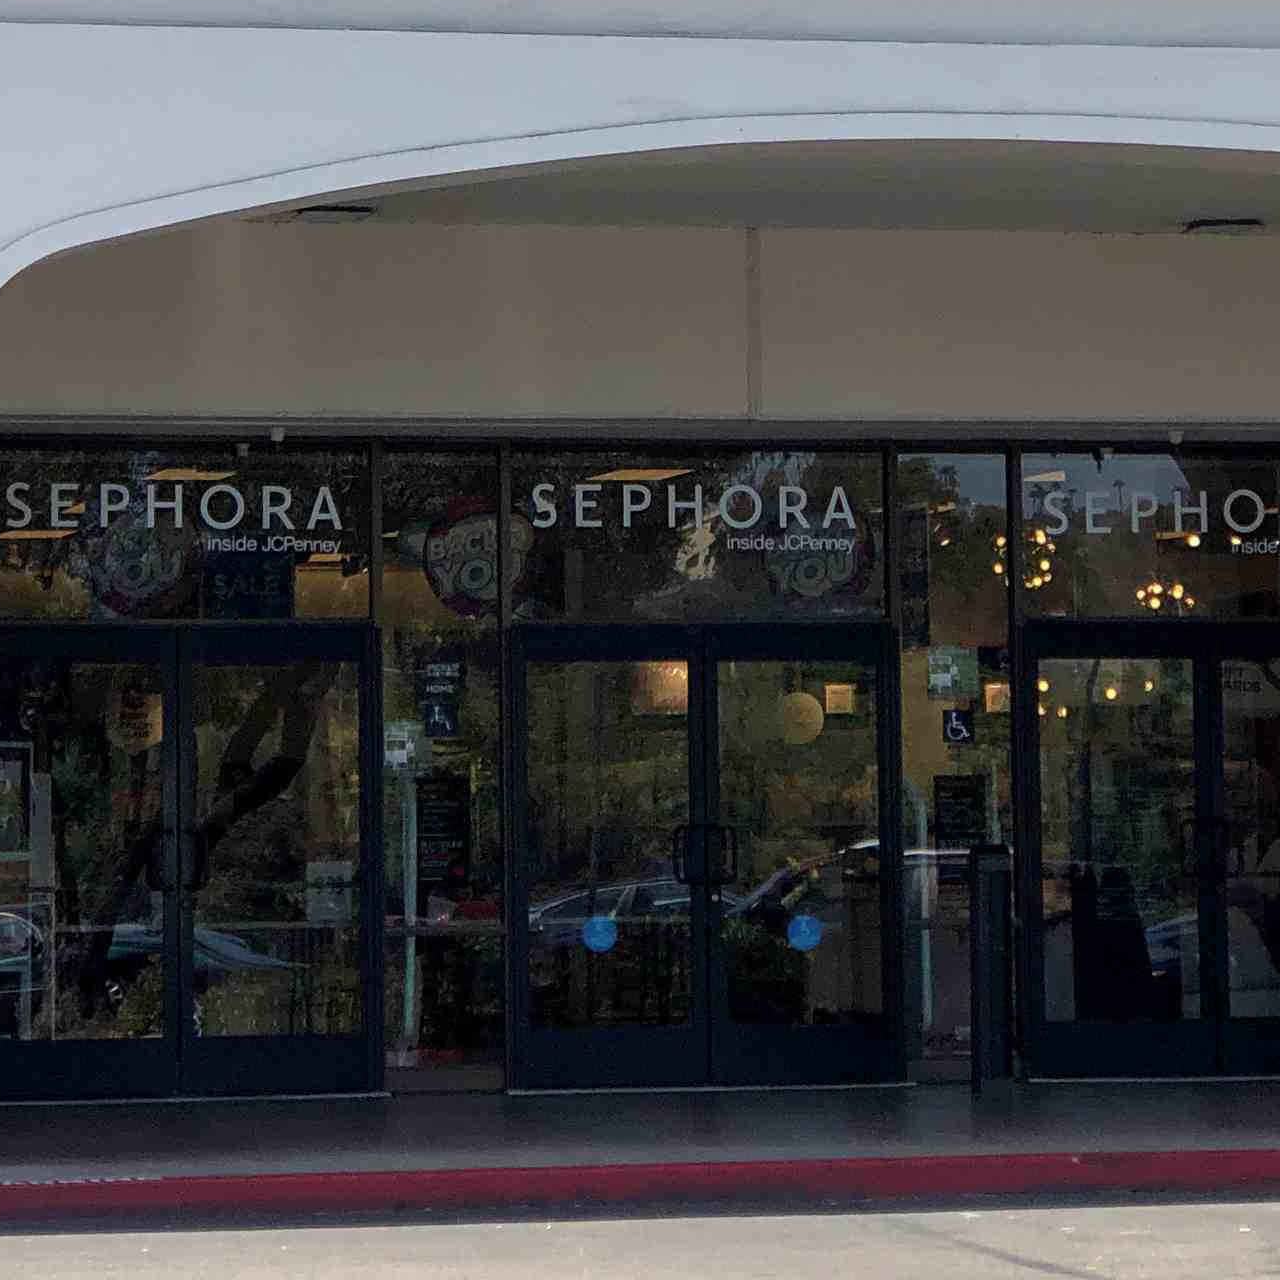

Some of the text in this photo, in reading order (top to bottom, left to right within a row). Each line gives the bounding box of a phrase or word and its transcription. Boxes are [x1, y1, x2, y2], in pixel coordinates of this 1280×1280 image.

[6, 481, 343, 531] SEPHORA
[531, 482, 857, 529] SEPHORA
[208, 535, 341, 553] inside JCPenney
[726, 535, 856, 555] inside JCPenney
[1232, 538, 1279, 554] inside
